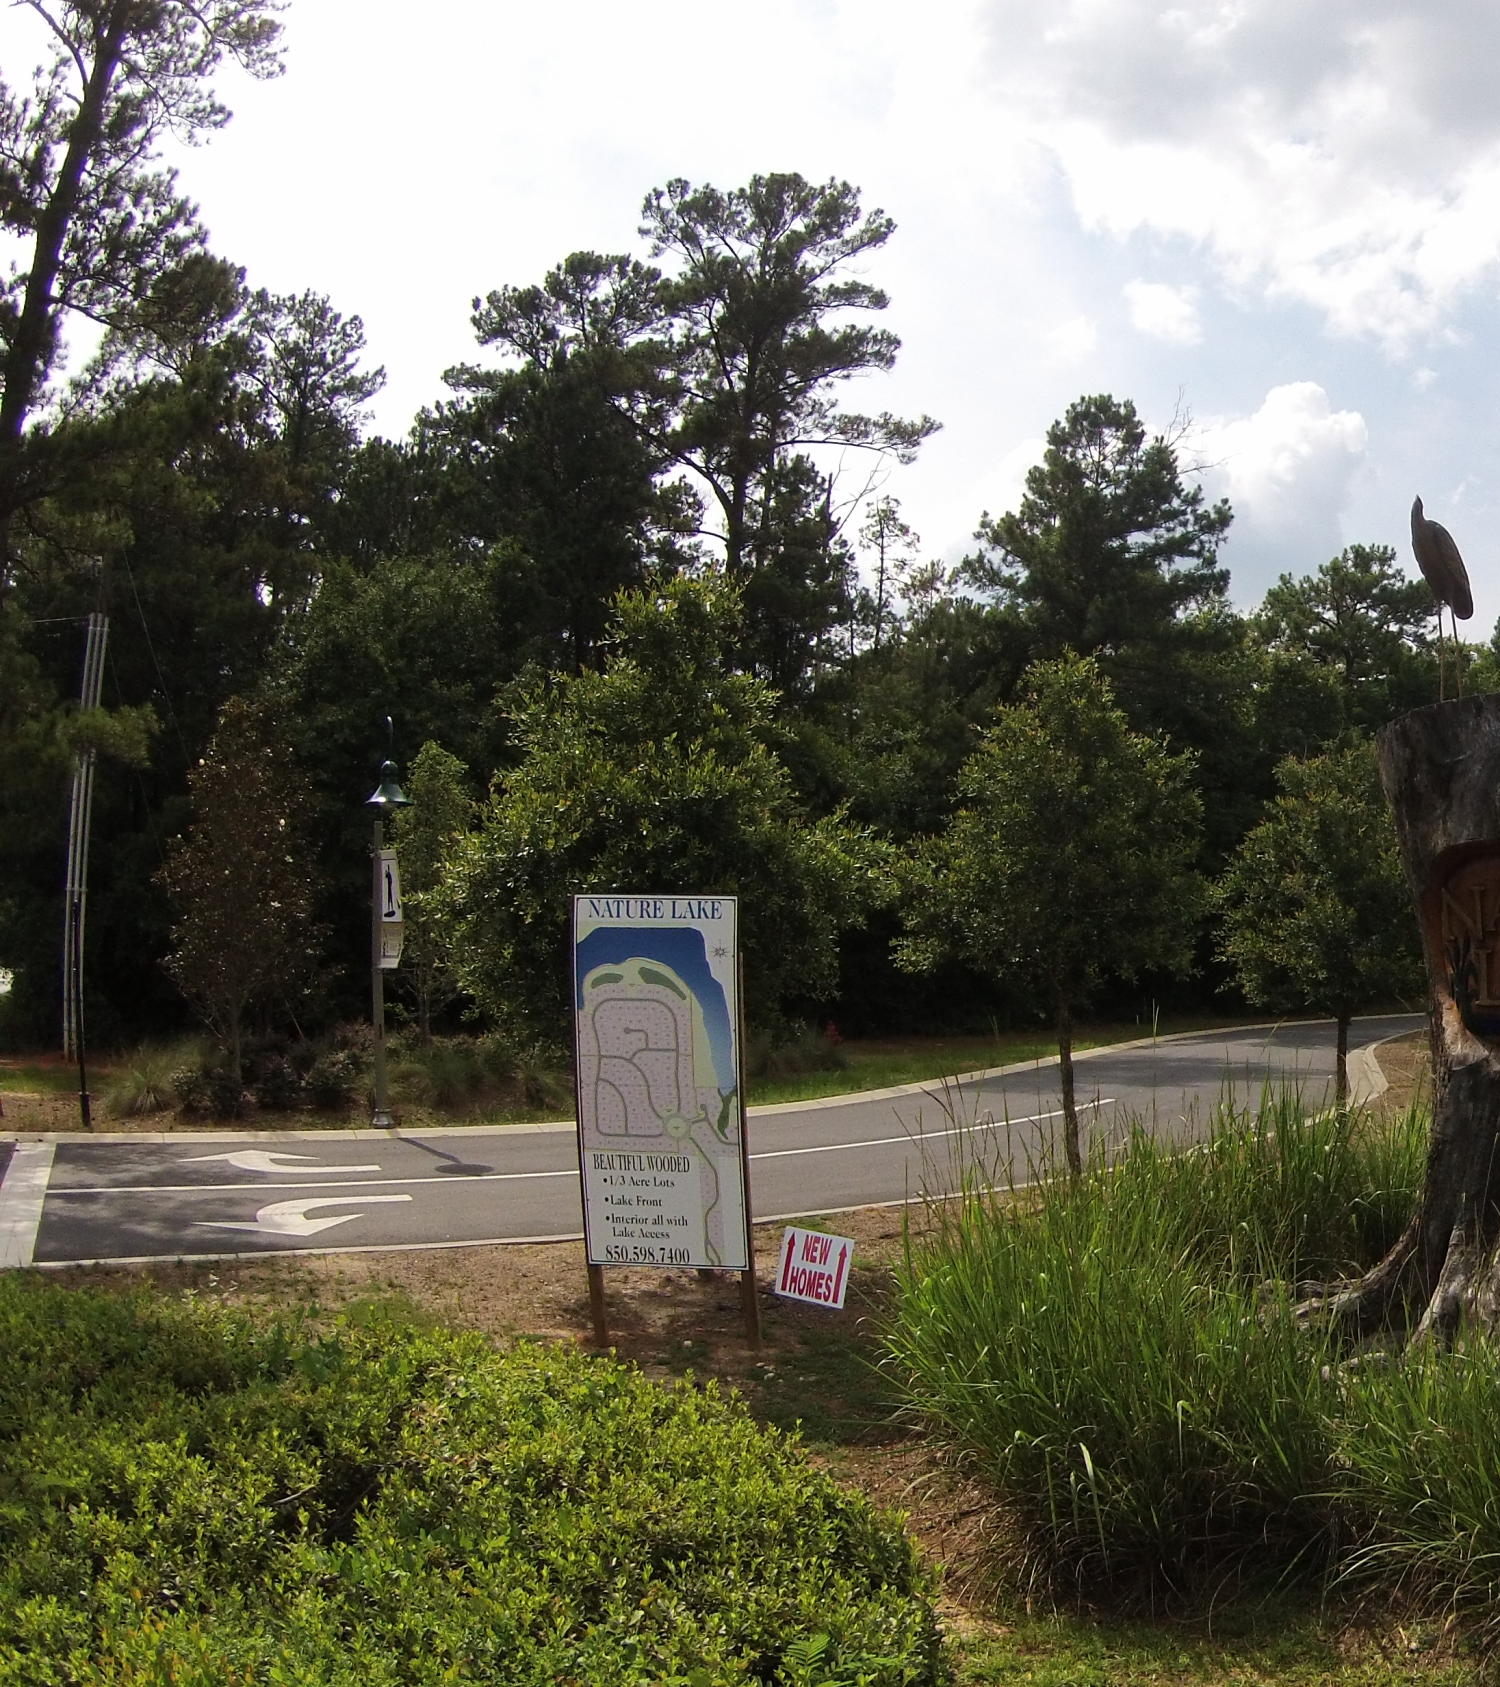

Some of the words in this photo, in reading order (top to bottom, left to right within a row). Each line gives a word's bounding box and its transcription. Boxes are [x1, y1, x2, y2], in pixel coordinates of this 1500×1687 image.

[589, 900, 665, 918] NATURE
[671, 901, 723, 919] LAKE
[593, 1153, 645, 1171] BEAUTIFUL
[647, 1155, 690, 1173] WOODED
[629, 1176, 650, 1187] Acre
[653, 1177, 675, 1188] Lots
[610, 1195, 633, 1206] Lake
[636, 1195, 662, 1207] Front
[611, 1213, 648, 1224] Interior
[652, 1215, 664, 1226] all
[666, 1215, 688, 1227] with
[613, 1226, 635, 1238] Lake
[638, 1228, 670, 1239] Access
[605, 1245, 690, 1263] 850.598.7400
[801, 1234, 832, 1265] NEW
[788, 1266, 833, 1302] HOMES
